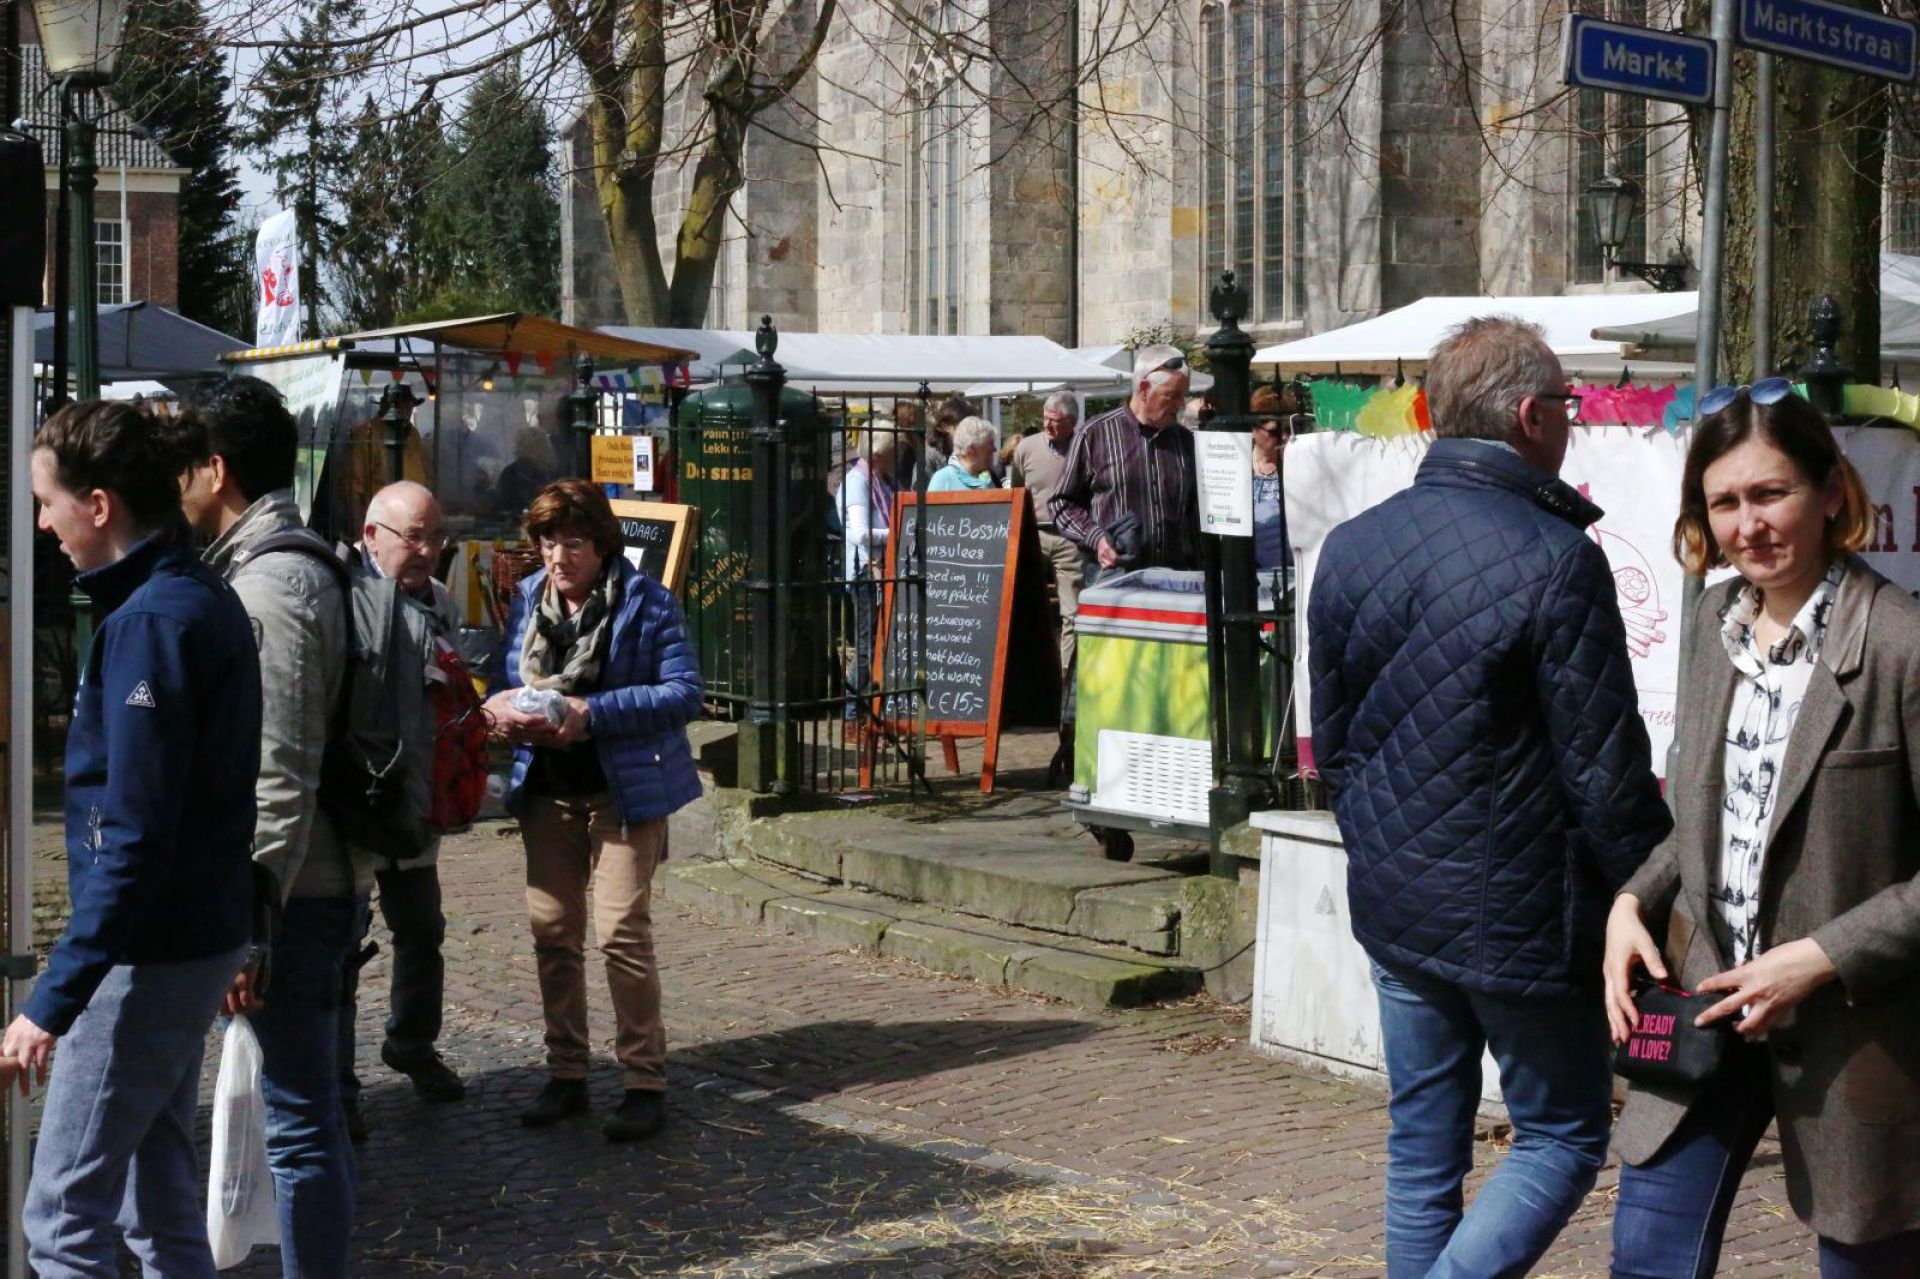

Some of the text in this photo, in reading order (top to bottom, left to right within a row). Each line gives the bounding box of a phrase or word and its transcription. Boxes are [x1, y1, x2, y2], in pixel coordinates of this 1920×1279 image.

[1603, 41, 1687, 84] Markt
[1632, 1013, 1676, 1035] READY
[1628, 1039, 1672, 1062] IN LOVE?
